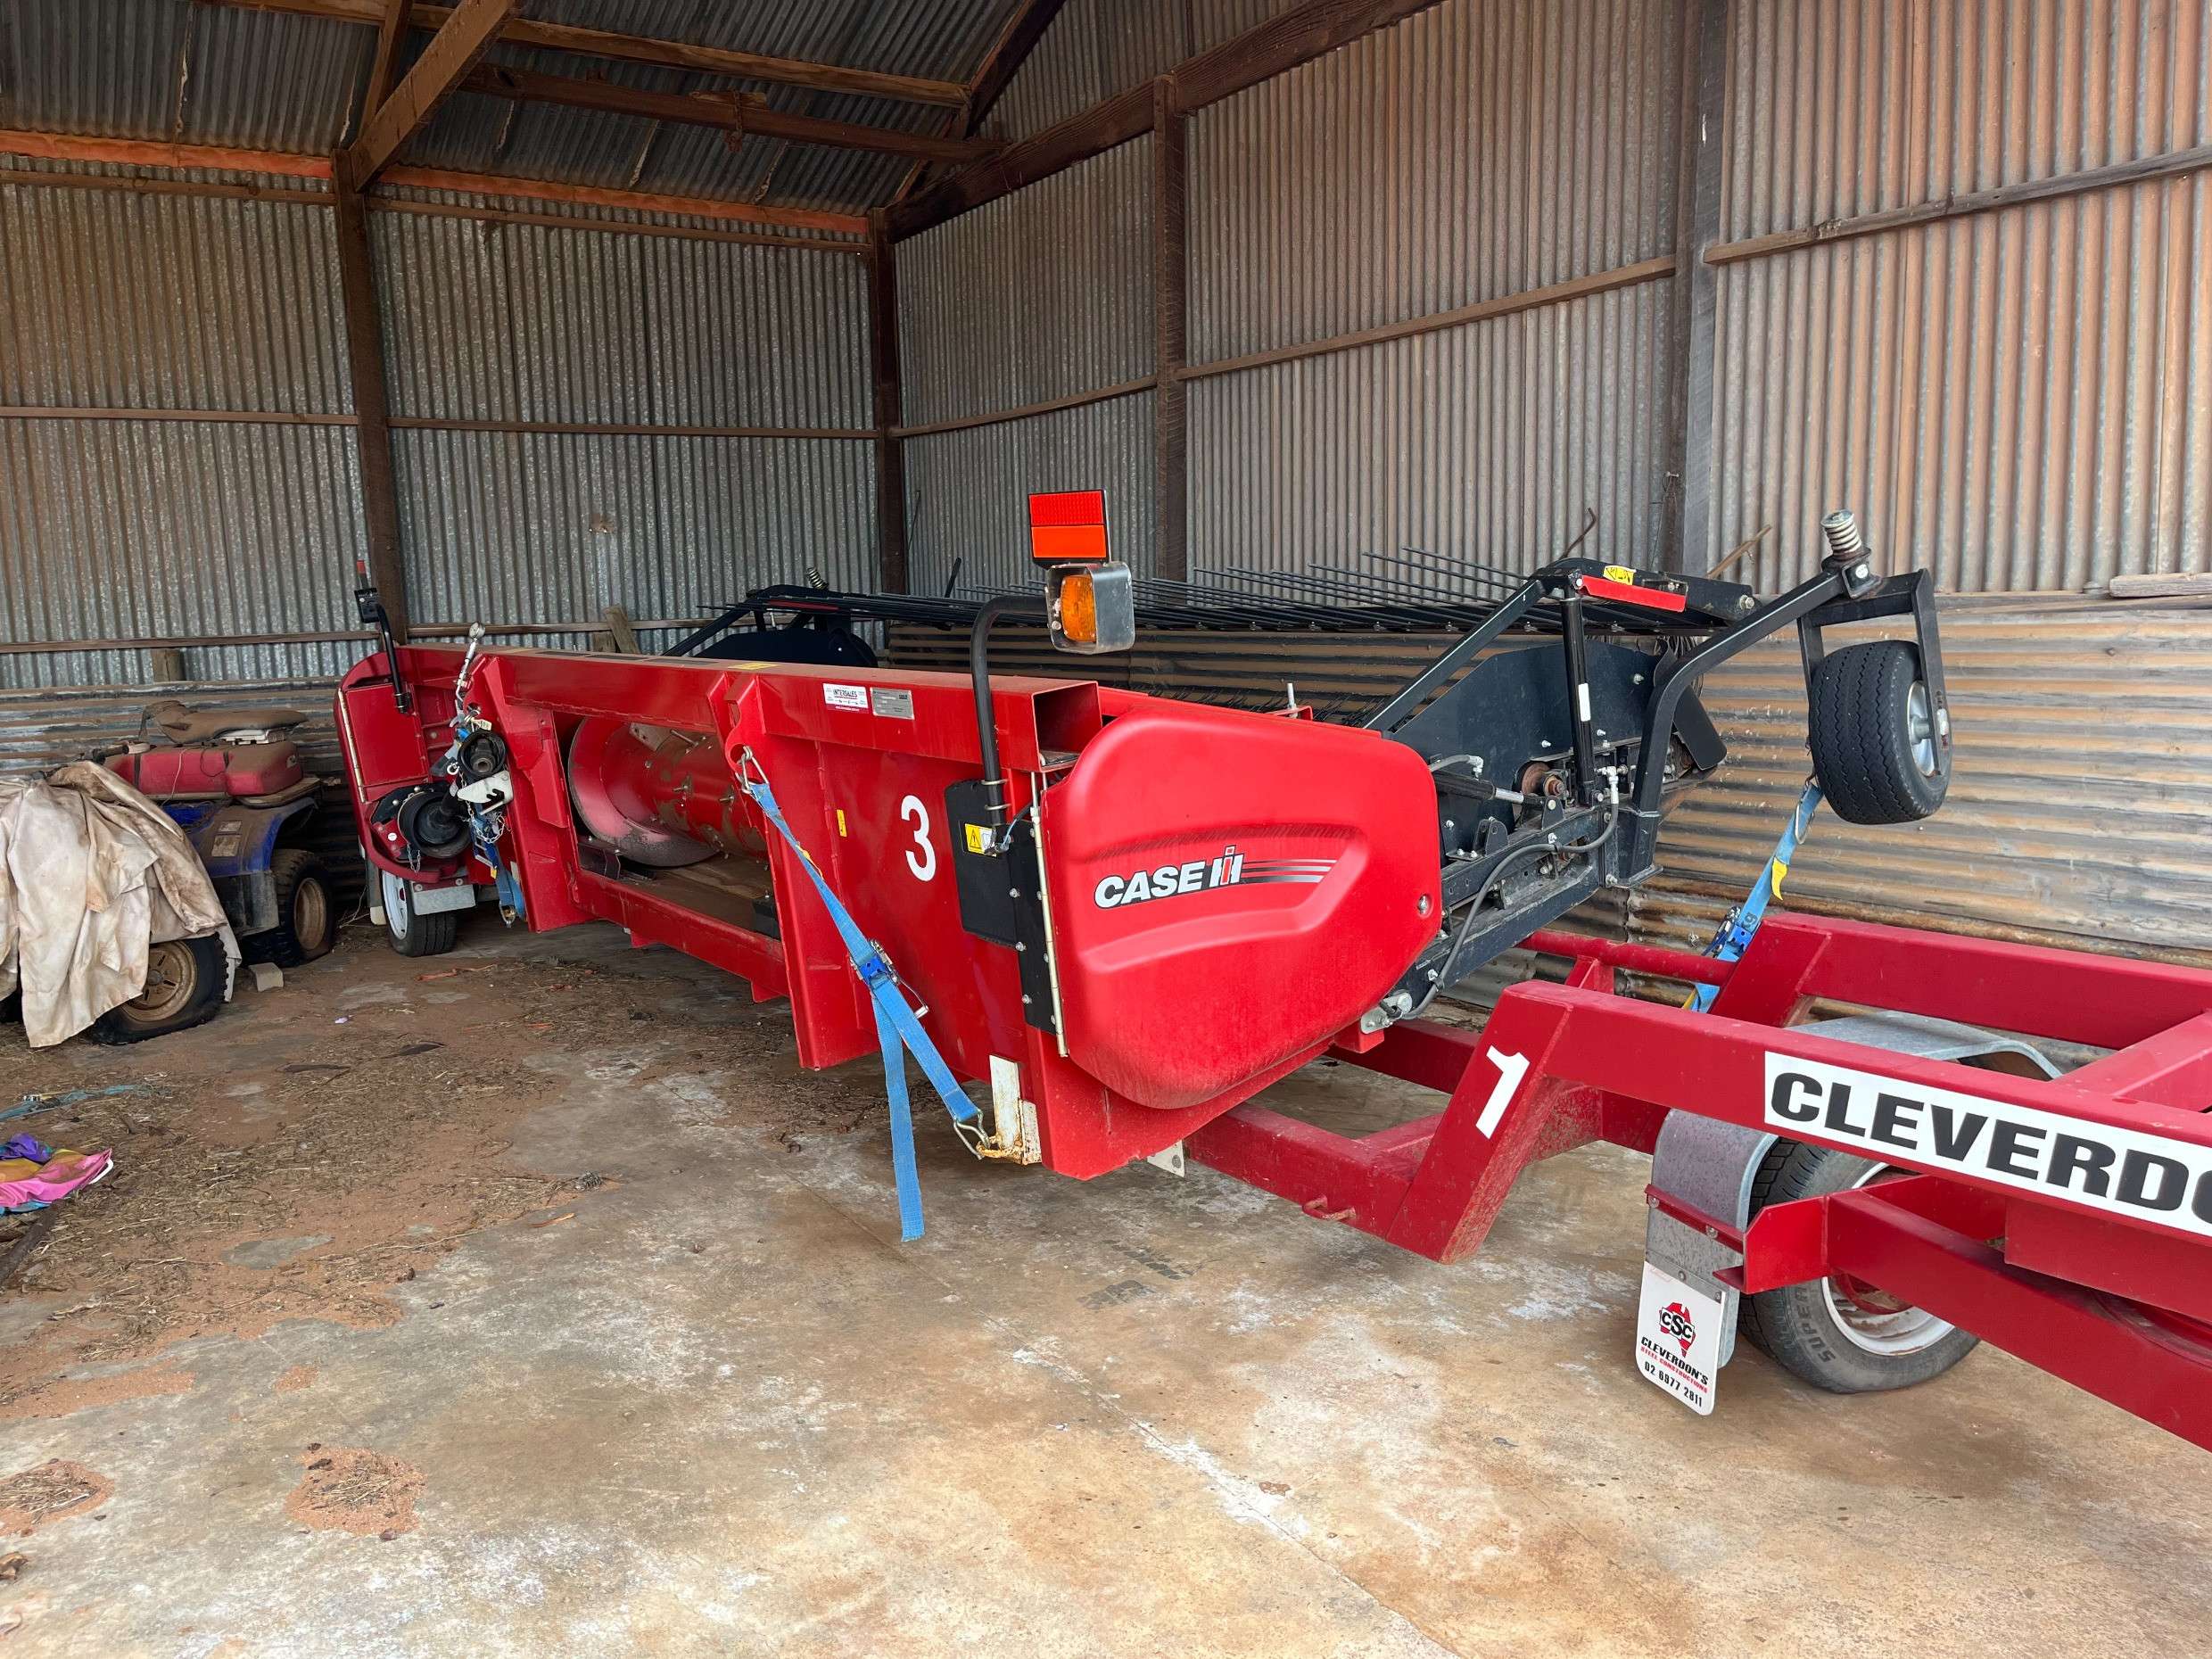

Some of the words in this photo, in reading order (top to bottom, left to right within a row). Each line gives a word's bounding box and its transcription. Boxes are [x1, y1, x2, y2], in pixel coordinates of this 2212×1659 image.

[901, 795, 937, 882] 3
[1094, 861, 1205, 909] CASE
[1475, 1044, 1531, 1140] 1
[1661, 1311, 1693, 1340] CSC
[1640, 1345, 1659, 1362] STEEL
[1659, 1358, 1708, 1394] CONSTRUCTIONS
[1641, 1336, 1709, 1385] CLEVERDON'S
[1645, 1361, 1655, 1375] 02
[1684, 1386, 1702, 1407] 2811
